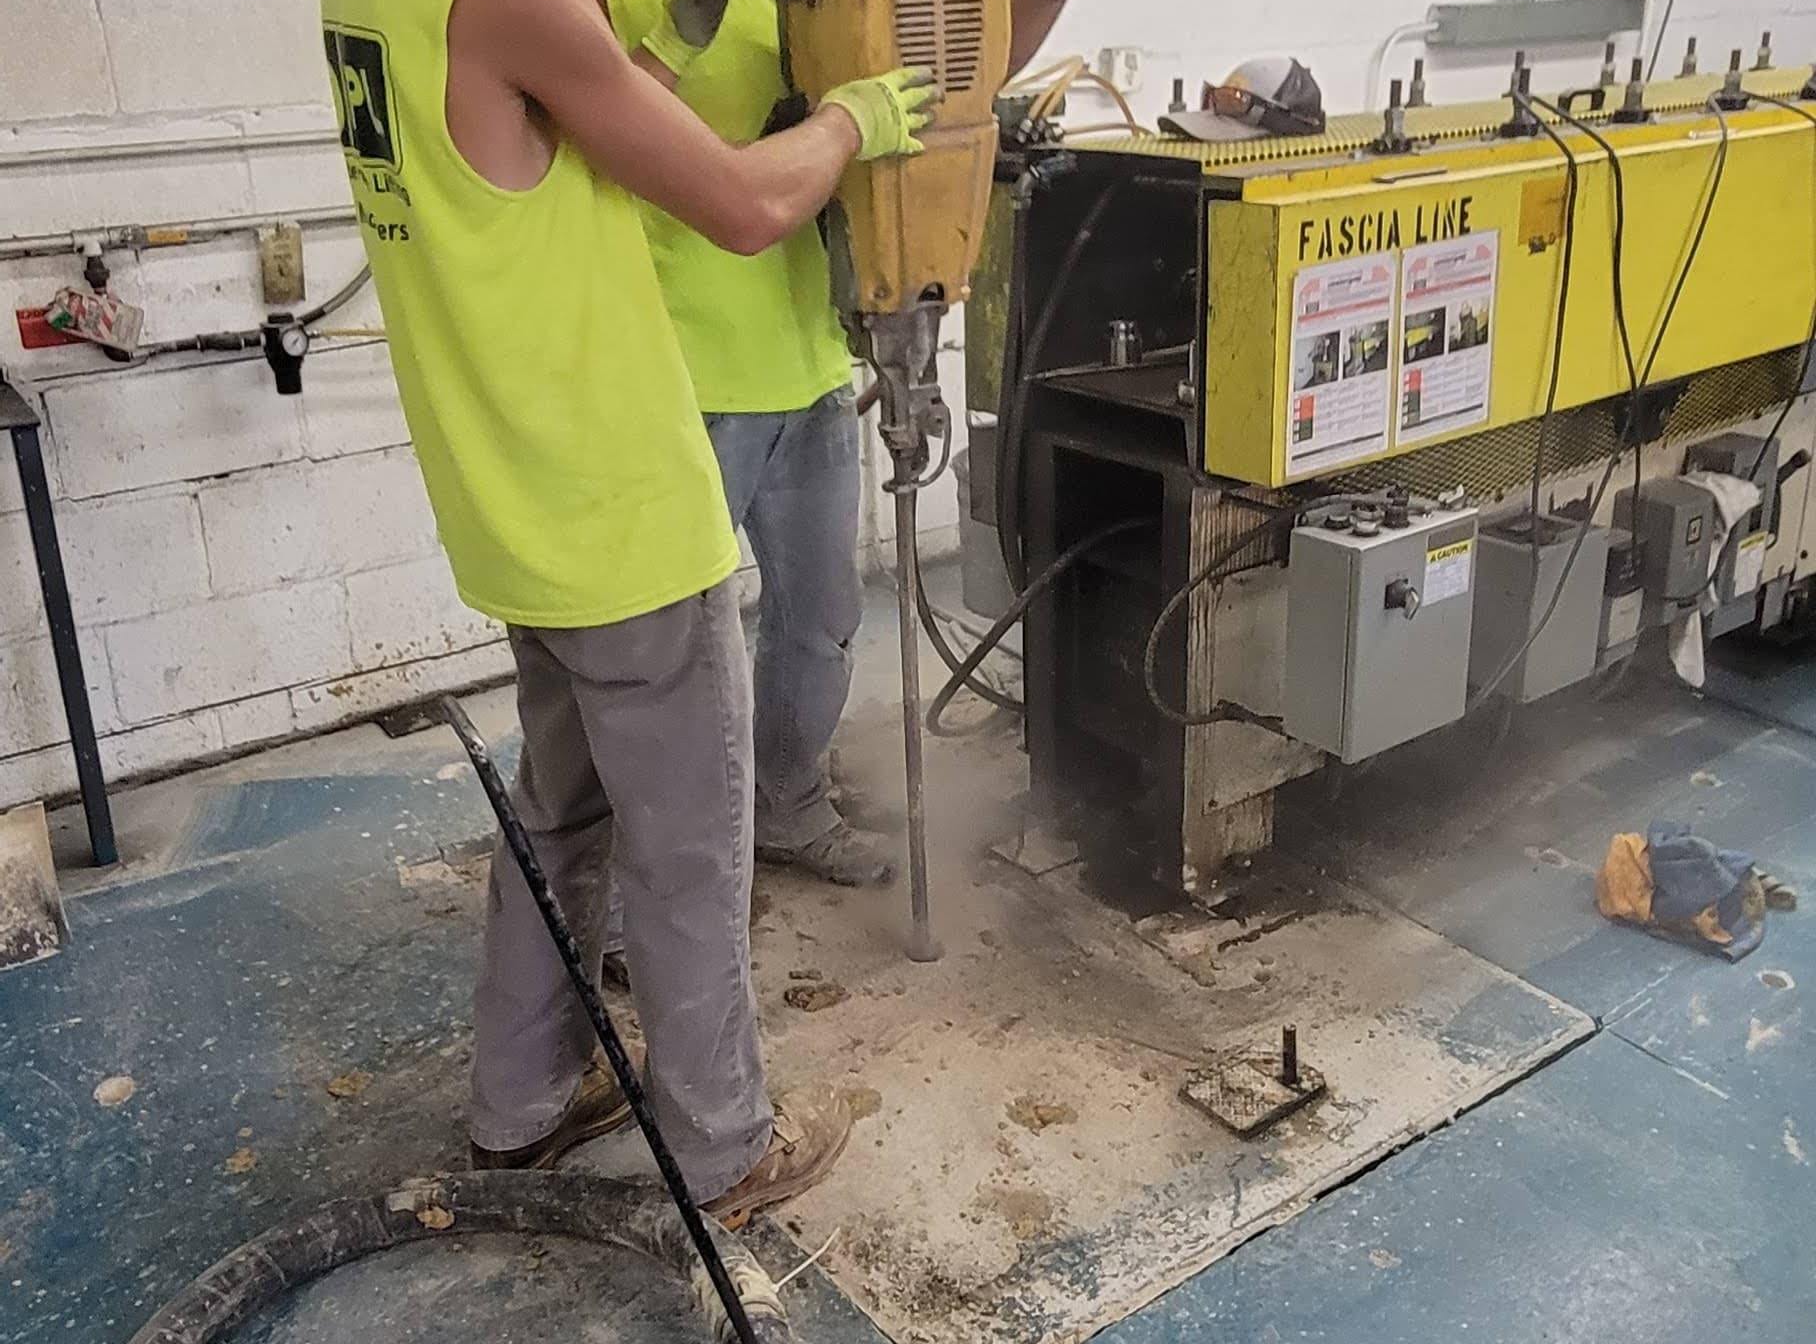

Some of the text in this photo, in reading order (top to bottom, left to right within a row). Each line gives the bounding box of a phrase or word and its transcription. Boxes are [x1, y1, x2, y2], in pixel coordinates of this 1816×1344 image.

[1298, 208, 1401, 261] FASCIA
[1415, 195, 1473, 246] LINE
[1436, 543, 1469, 561] CAUTION
